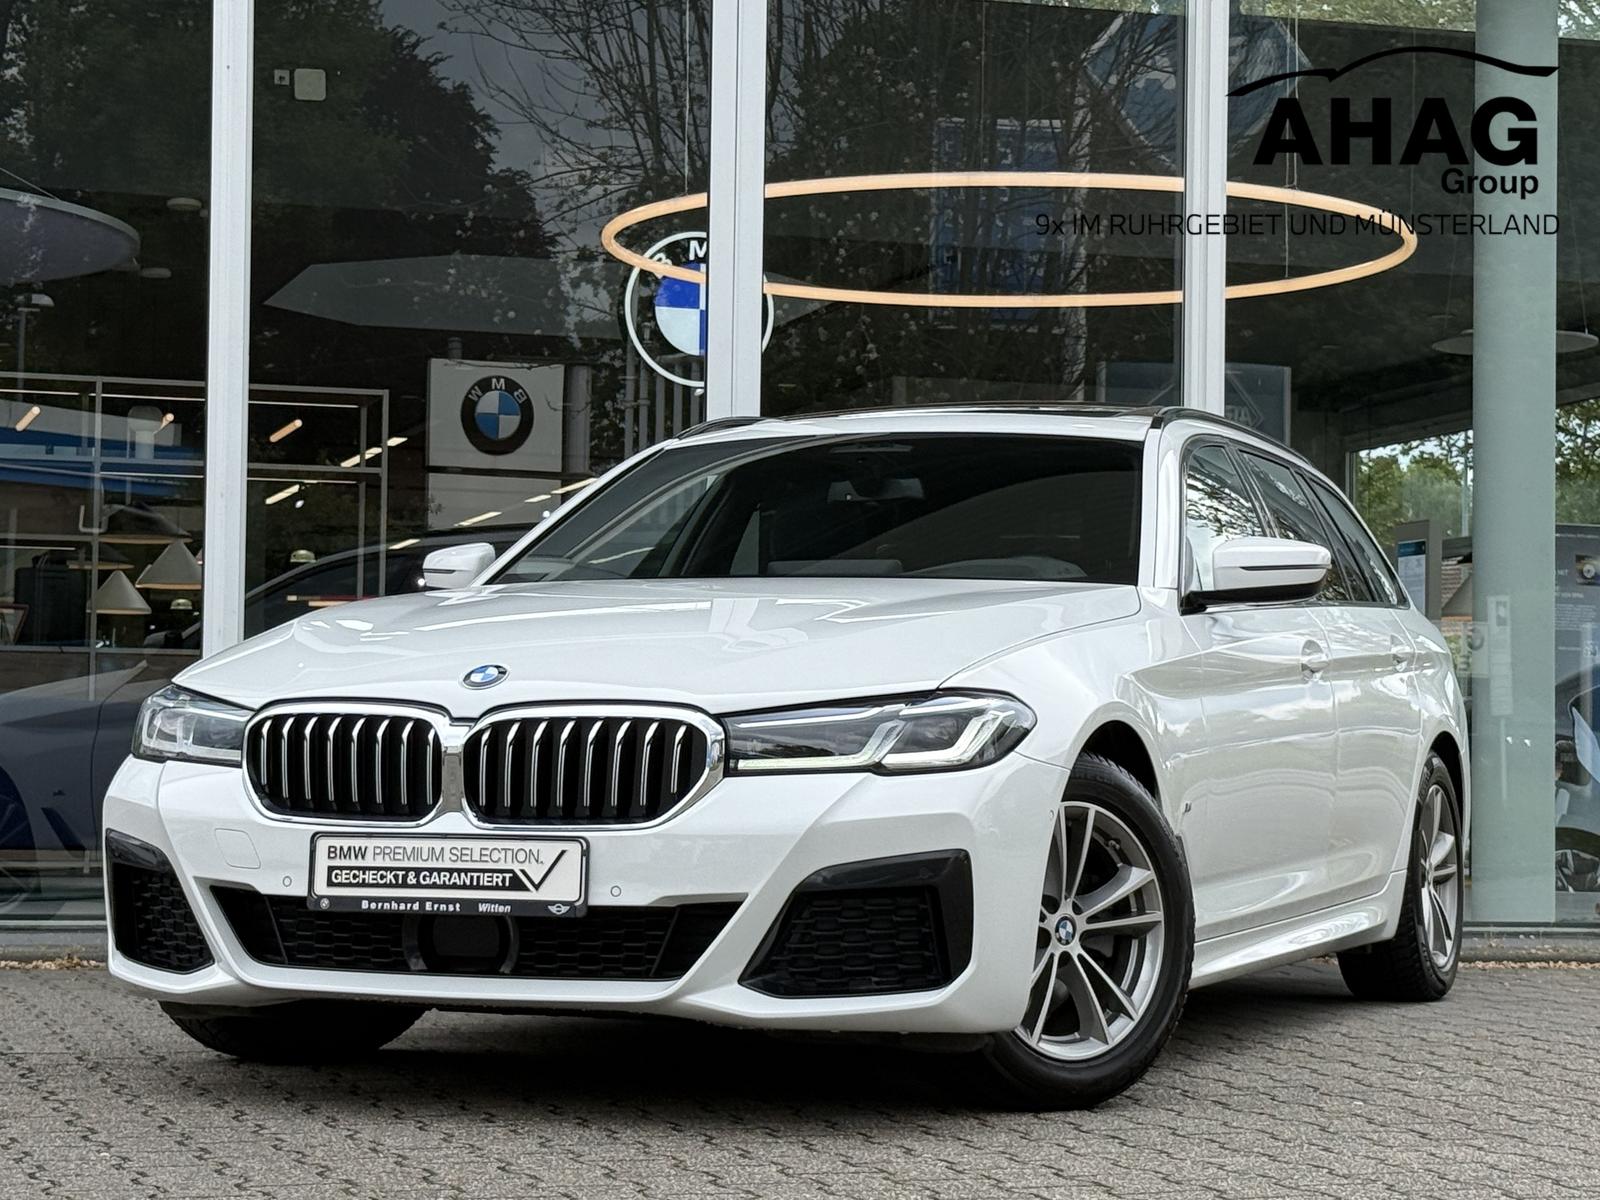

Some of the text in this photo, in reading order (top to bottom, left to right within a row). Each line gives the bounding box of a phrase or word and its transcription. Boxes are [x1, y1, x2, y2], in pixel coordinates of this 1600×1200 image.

[327, 846, 544, 864] BMW PREMIUM SELECTION.
[331, 869, 512, 886] GECHECKT & GARANTIERT
[361, 900, 511, 913] Bernhard Ernst Witten
